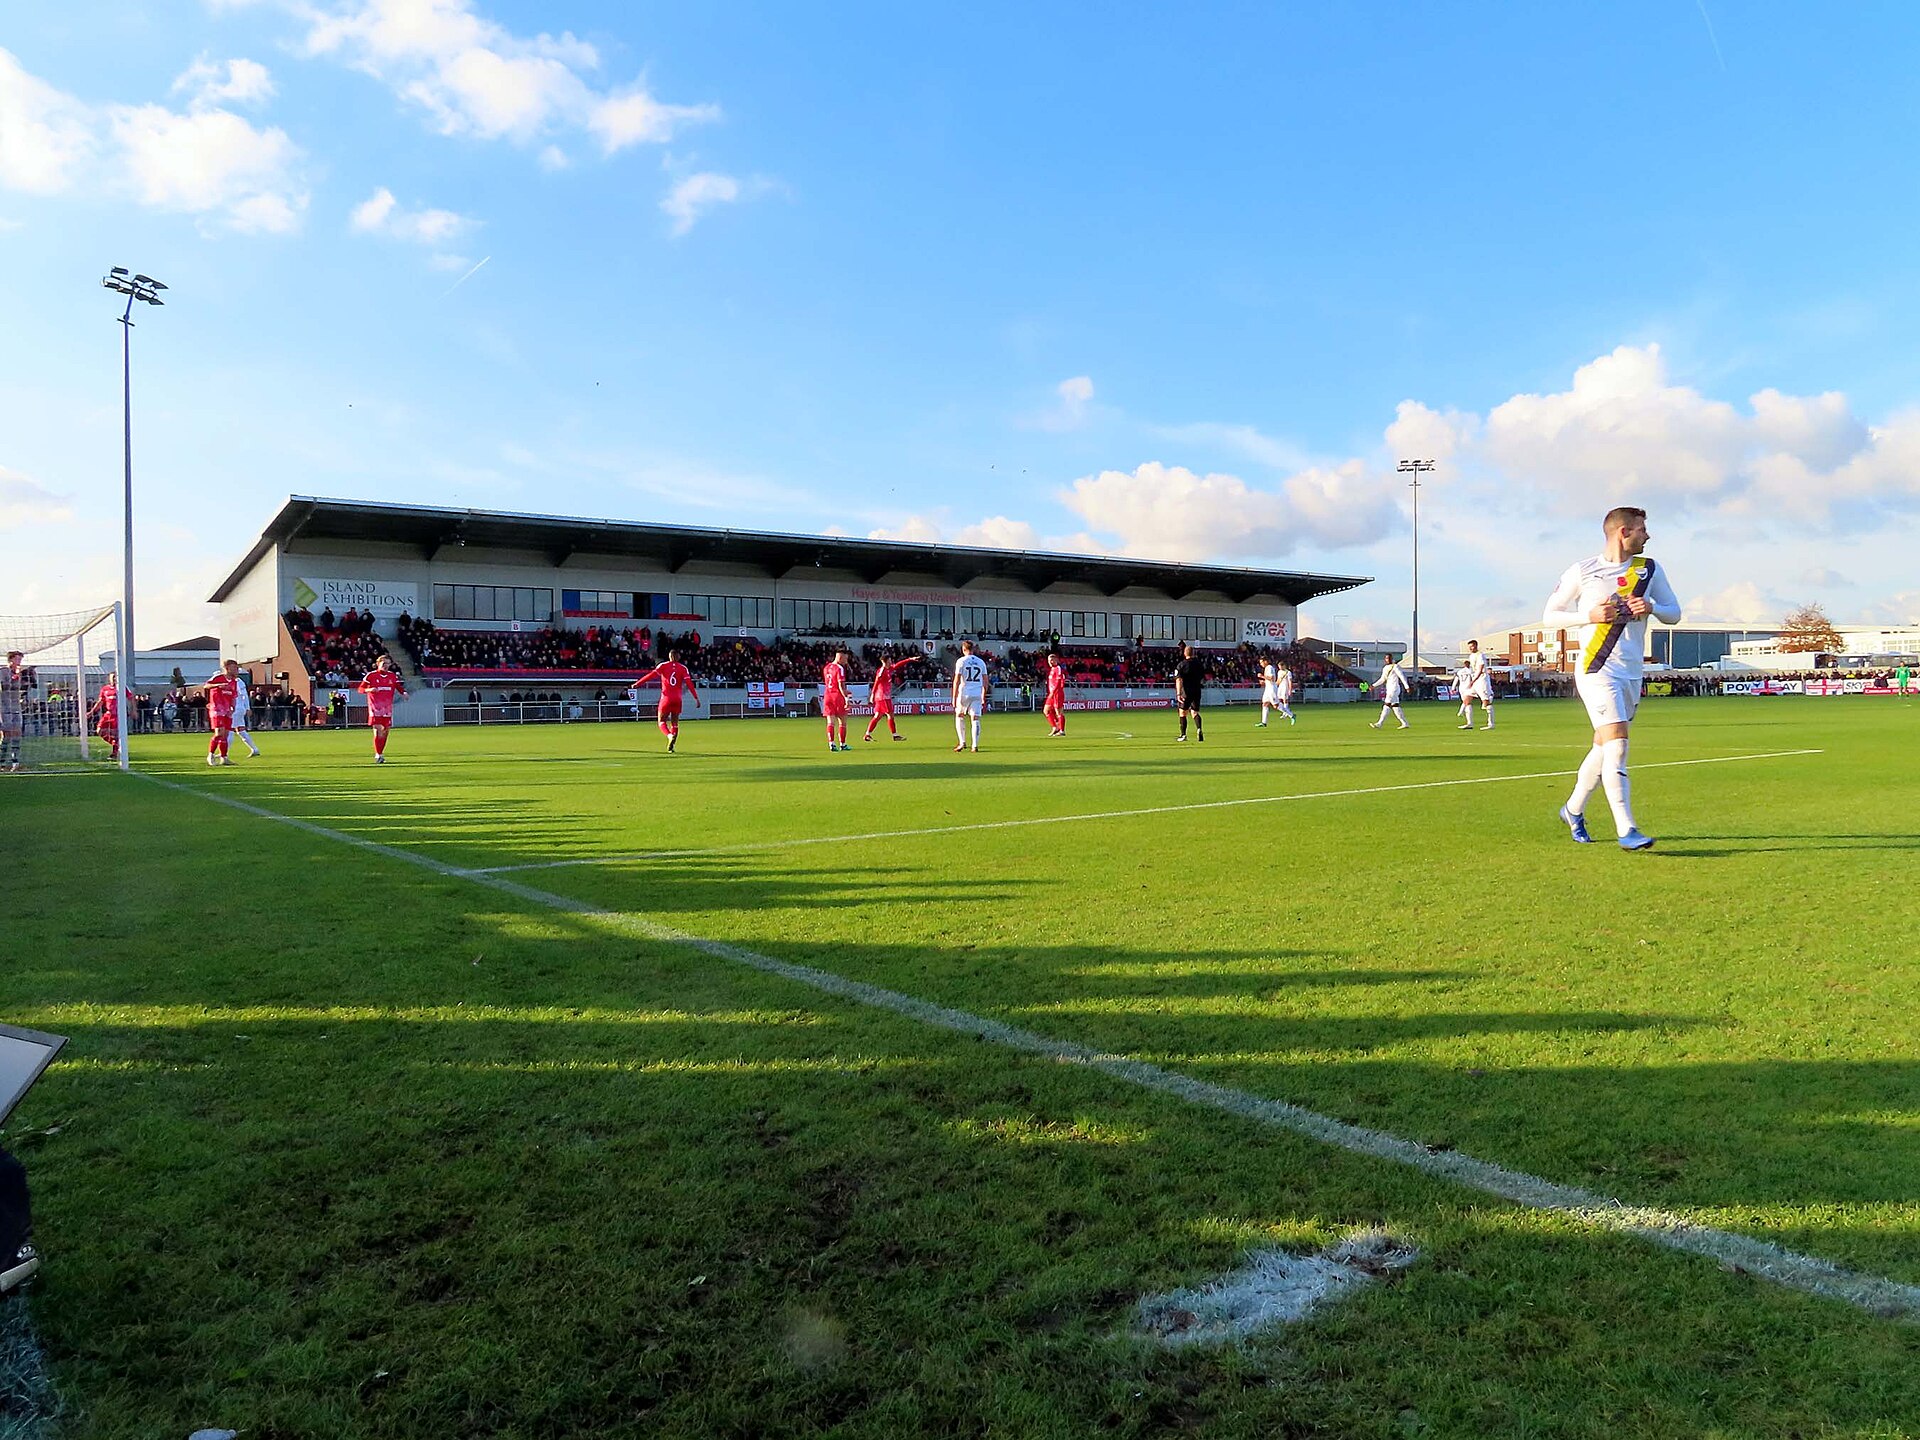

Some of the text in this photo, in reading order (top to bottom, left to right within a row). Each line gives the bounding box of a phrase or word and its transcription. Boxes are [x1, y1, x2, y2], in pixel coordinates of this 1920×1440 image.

[323, 581, 376, 593] ISLAND
[323, 593, 415, 607] EXHIBITIONS
[851, 587, 880, 600] Hayes
[892, 589, 928, 603] Yeading
[929, 592, 961, 603] United
[669, 671, 677, 686] 6
[826, 673, 833, 688] 2
[965, 666, 981, 682] 12
[847, 704, 875, 714] mirat
[1063, 700, 1086, 710] mirates
